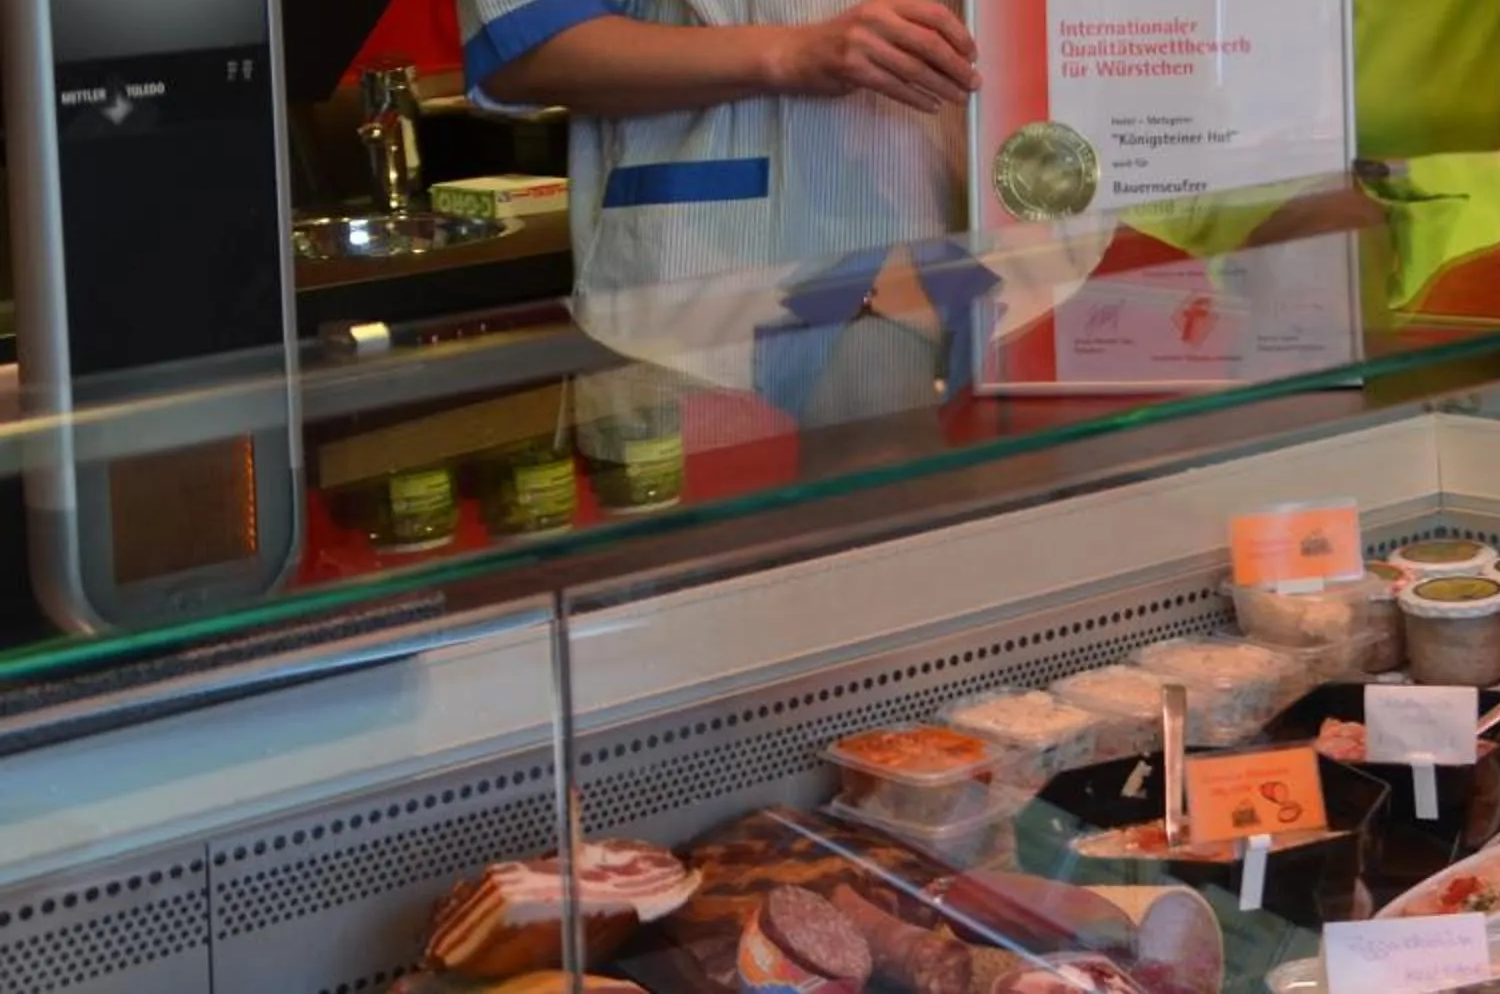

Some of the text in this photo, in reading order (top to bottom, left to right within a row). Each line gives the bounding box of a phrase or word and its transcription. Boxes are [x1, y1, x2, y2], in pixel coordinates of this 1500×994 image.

[1059, 17, 1199, 38] Internationaler
[1061, 35, 1252, 58] Qualitätswettbewerb
[1061, 59, 1195, 78] für Würstchen
[125, 81, 165, 98] TOLEDO
